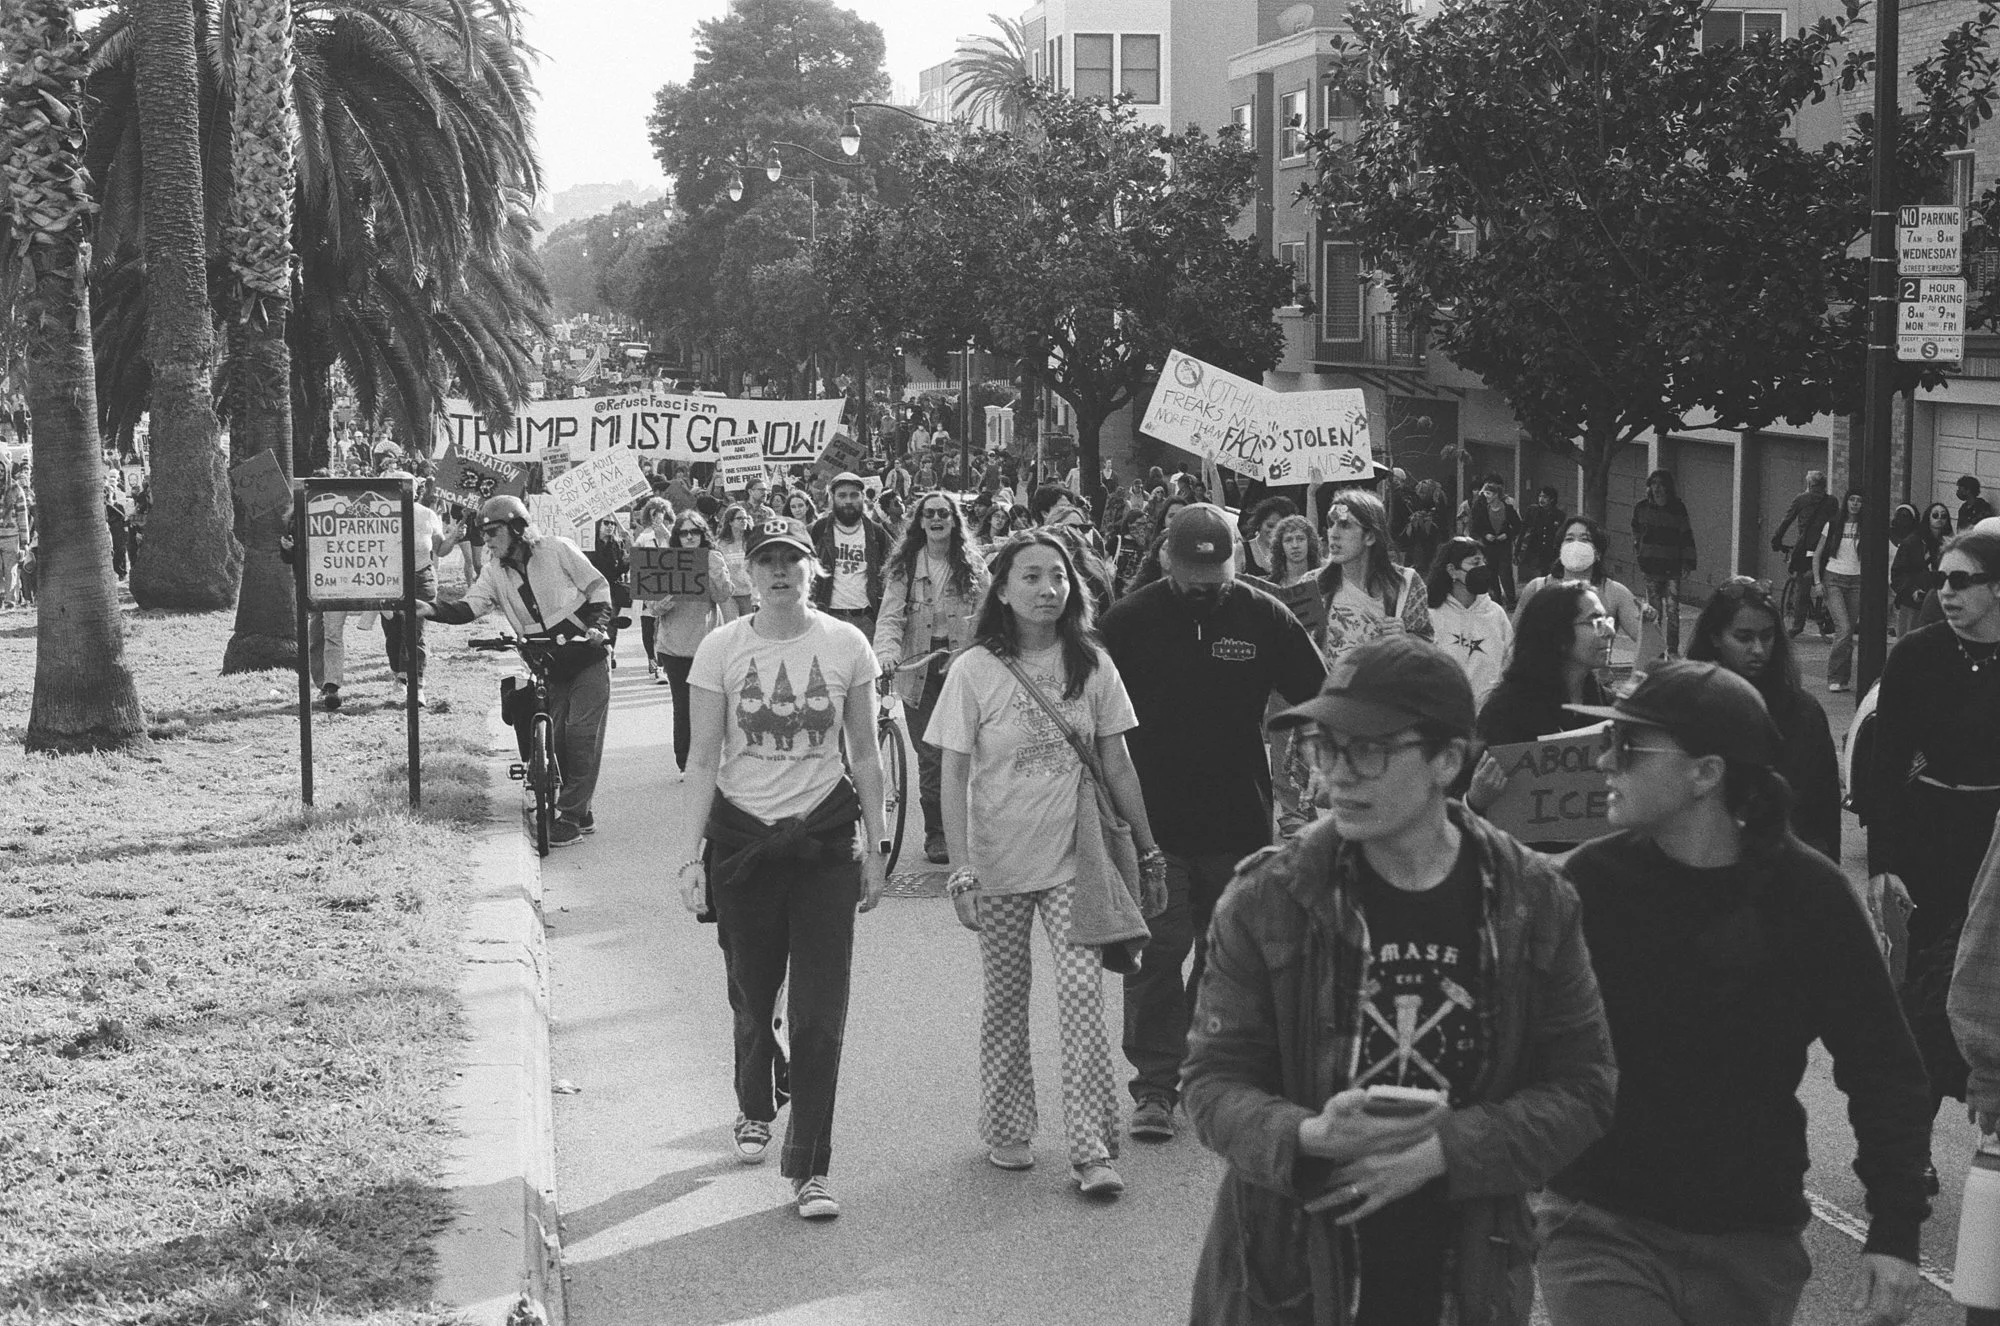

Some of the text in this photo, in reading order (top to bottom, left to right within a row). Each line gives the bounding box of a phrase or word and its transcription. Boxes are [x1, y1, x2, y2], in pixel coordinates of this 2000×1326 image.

[1901, 208, 1959, 226] NO PARKING
[1902, 248, 1957, 260] WEDNESDAY
[1904, 282, 1955, 299] 2 HOUR
[1921, 294, 1962, 304] PARKING
[1905, 322, 1923, 331] MON
[1943, 322, 1956, 331] FRI
[1925, 344, 1935, 357] S
[1162, 389, 1224, 422] FREAKS
[449, 413, 578, 455] TRUMP
[591, 412, 680, 452] MUST
[686, 414, 737, 453] GO
[748, 419, 826, 457] NOW!
[1155, 407, 1225, 441] MORE THAN
[721, 436, 757, 447] IMMIGRANT
[1283, 424, 1353, 453] STOLEN
[453, 445, 520, 482] LIBERATION
[736, 464, 761, 473] STRUGGLE
[554, 475, 574, 495] SOY
[576, 465, 592, 480] DE
[592, 455, 615, 473] AQUI
[726, 475, 741, 484] ONE
[559, 487, 579, 507] SOY
[581, 476, 597, 493] DE
[600, 465, 623, 486] AYA
[433, 486, 483, 511] INCARCER
[310, 515, 399, 536] NO PARKING
[327, 540, 385, 553] EXCEPT
[323, 555, 388, 569] SUNDAY
[639, 548, 694, 571] ICE
[314, 573, 337, 587] 8AM
[351, 572, 400, 586] 4:30PM
[637, 571, 706, 596] KILLS
[1507, 745, 1600, 778] ABOL
[1528, 790, 1607, 824] ICE
